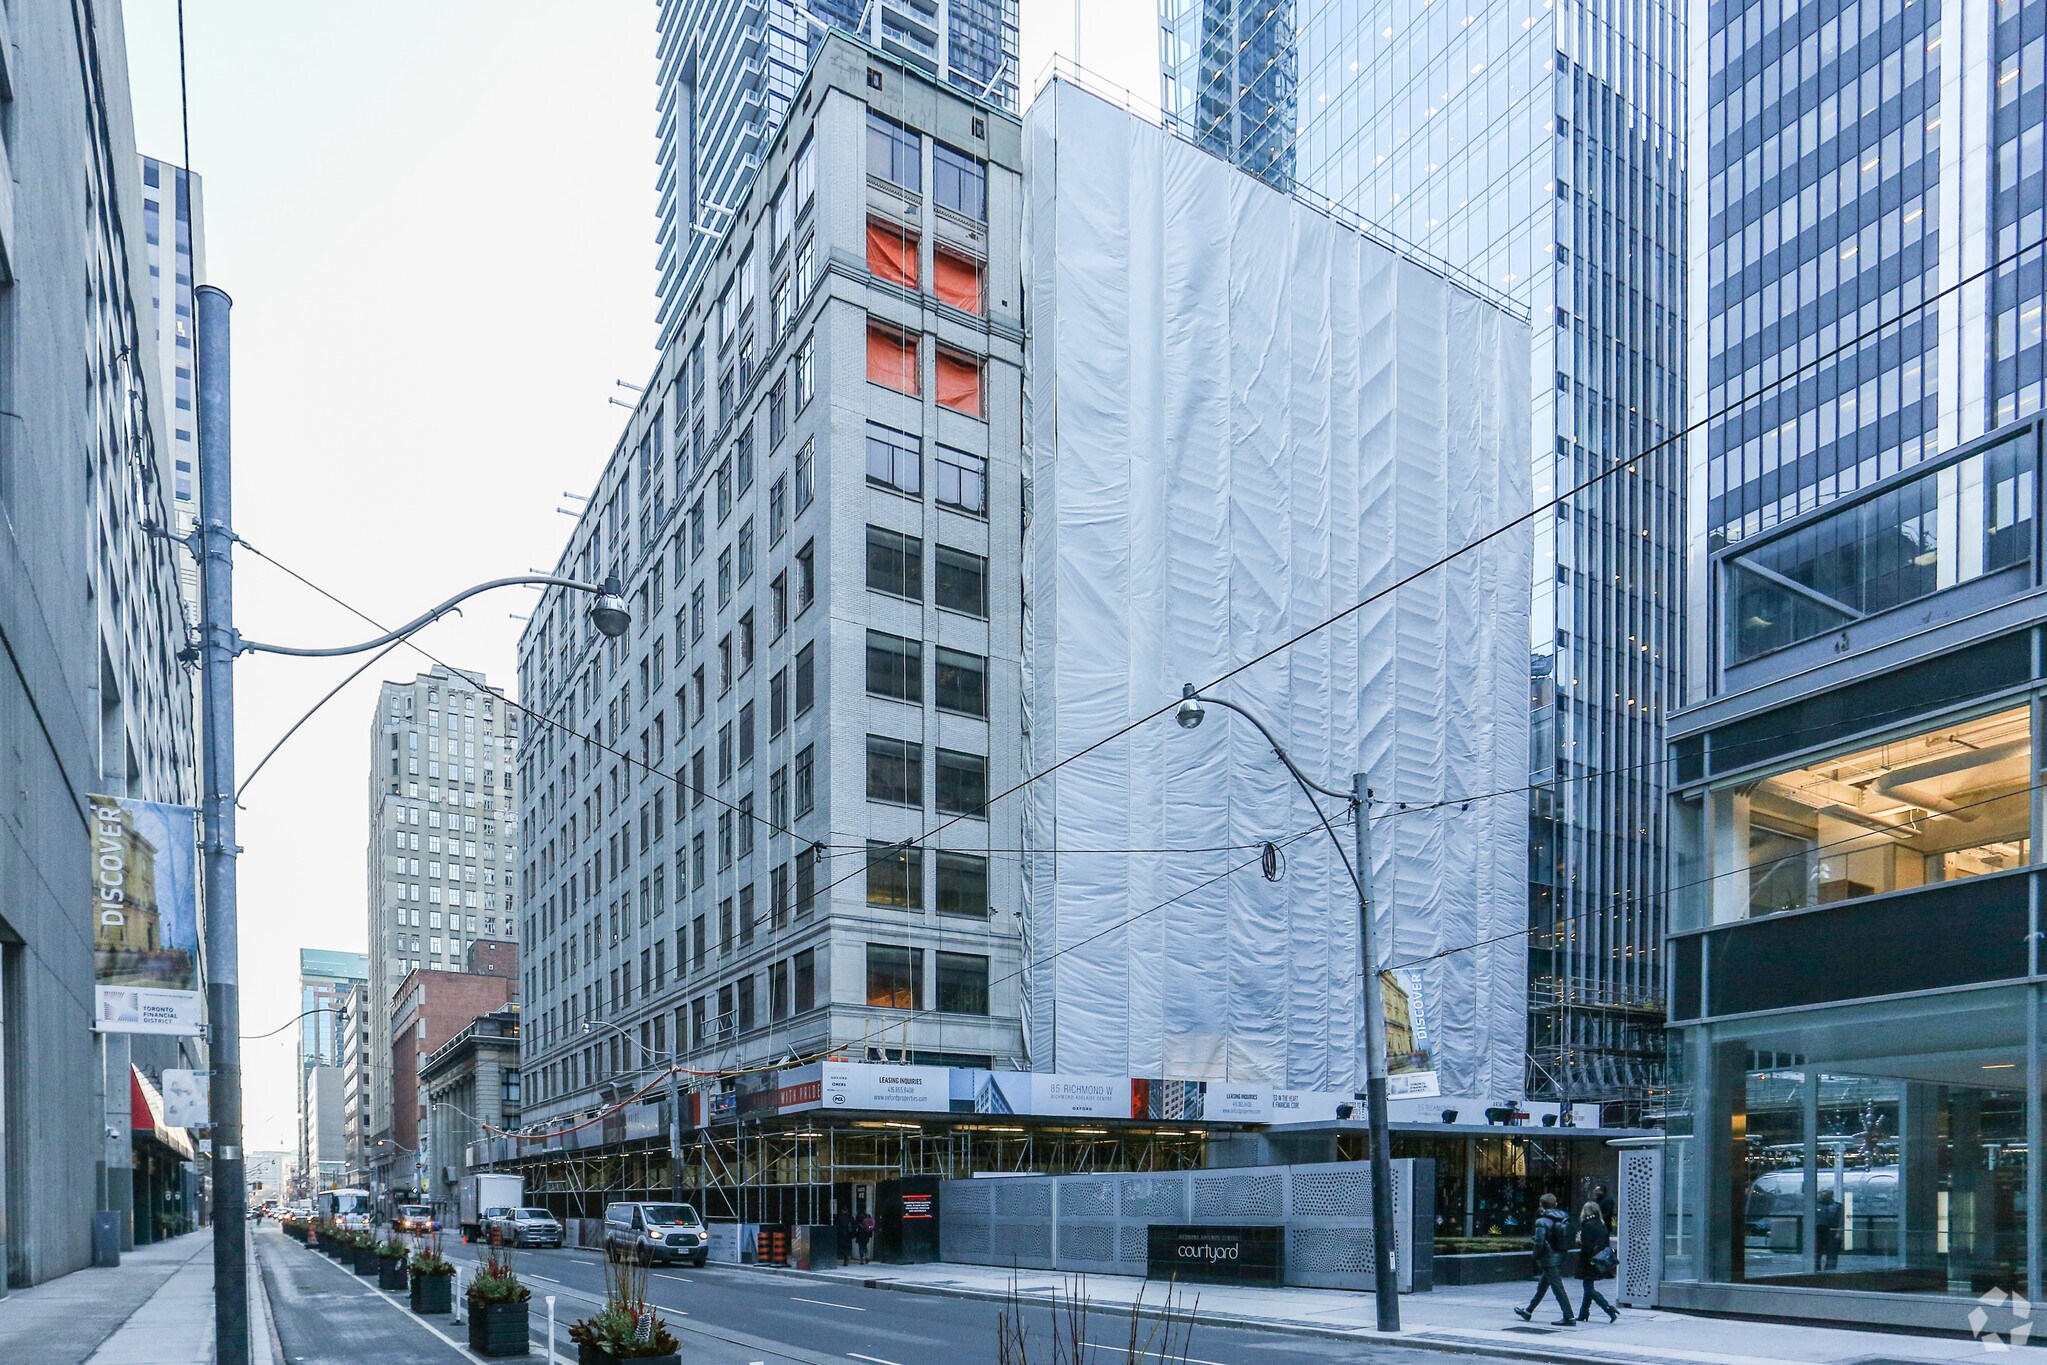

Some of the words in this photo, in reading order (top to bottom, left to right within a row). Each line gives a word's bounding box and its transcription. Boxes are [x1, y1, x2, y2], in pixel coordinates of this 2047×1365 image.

[98, 806, 125, 927] DISCOVER
[143, 1005, 174, 1013] TORONTO
[1411, 973, 1428, 1040] DISCOVER
[143, 1011, 178, 1019] FINANCIAL
[143, 1017, 173, 1025] DISTRICT
[879, 1076, 899, 1084] LEASING
[899, 1077, 923, 1086] INQUIRIES
[780, 1088, 797, 1105] WITH
[799, 1083, 821, 1102] PRIDE
[1050, 1083, 1061, 1093] 85
[1063, 1084, 1104, 1096] RICHMOND
[1105, 1086, 1114, 1096] W
[873, 1094, 928, 1103] www.oxfordproperties.com
[1177, 1242, 1240, 1264] courtyard
